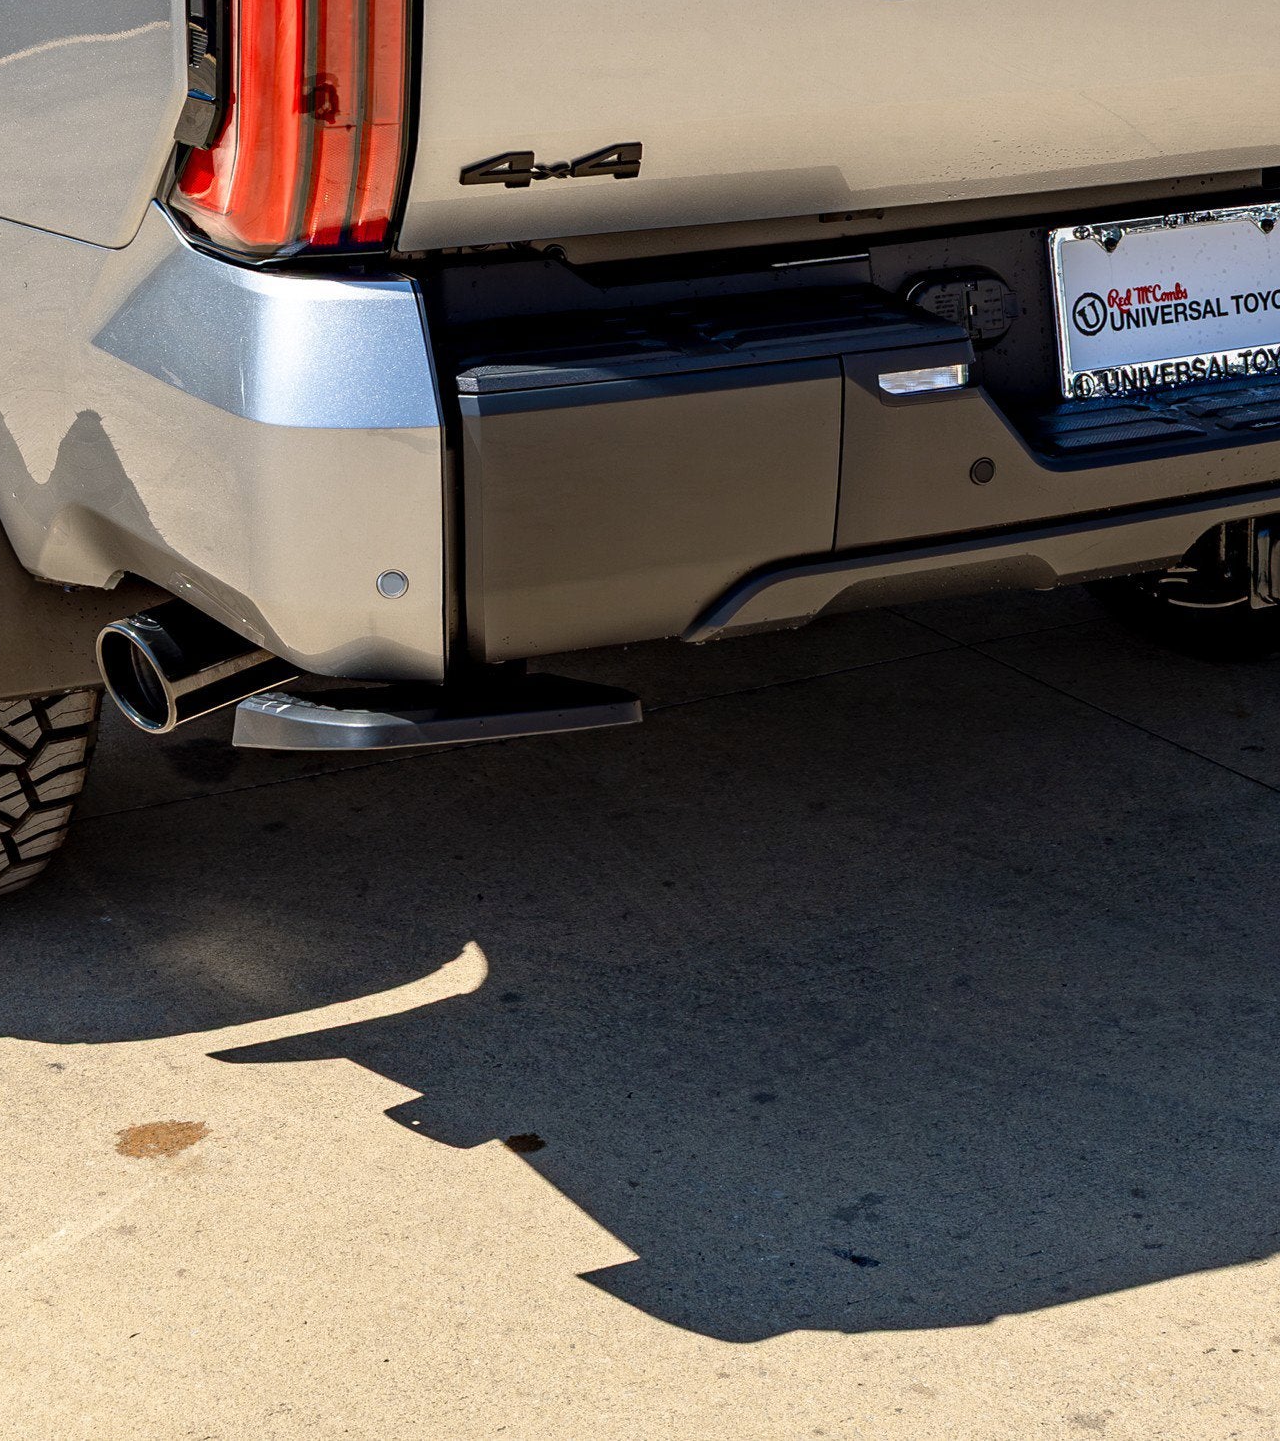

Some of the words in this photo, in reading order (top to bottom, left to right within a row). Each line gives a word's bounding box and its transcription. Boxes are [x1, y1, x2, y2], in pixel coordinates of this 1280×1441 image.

[459, 142, 643, 188] 4x4
[1107, 288, 1133, 313] Red
[1133, 282, 1188, 305] McCombs
[1110, 298, 1229, 331] UNIVERSAL
[1103, 355, 1235, 394] UNIVERSAL
